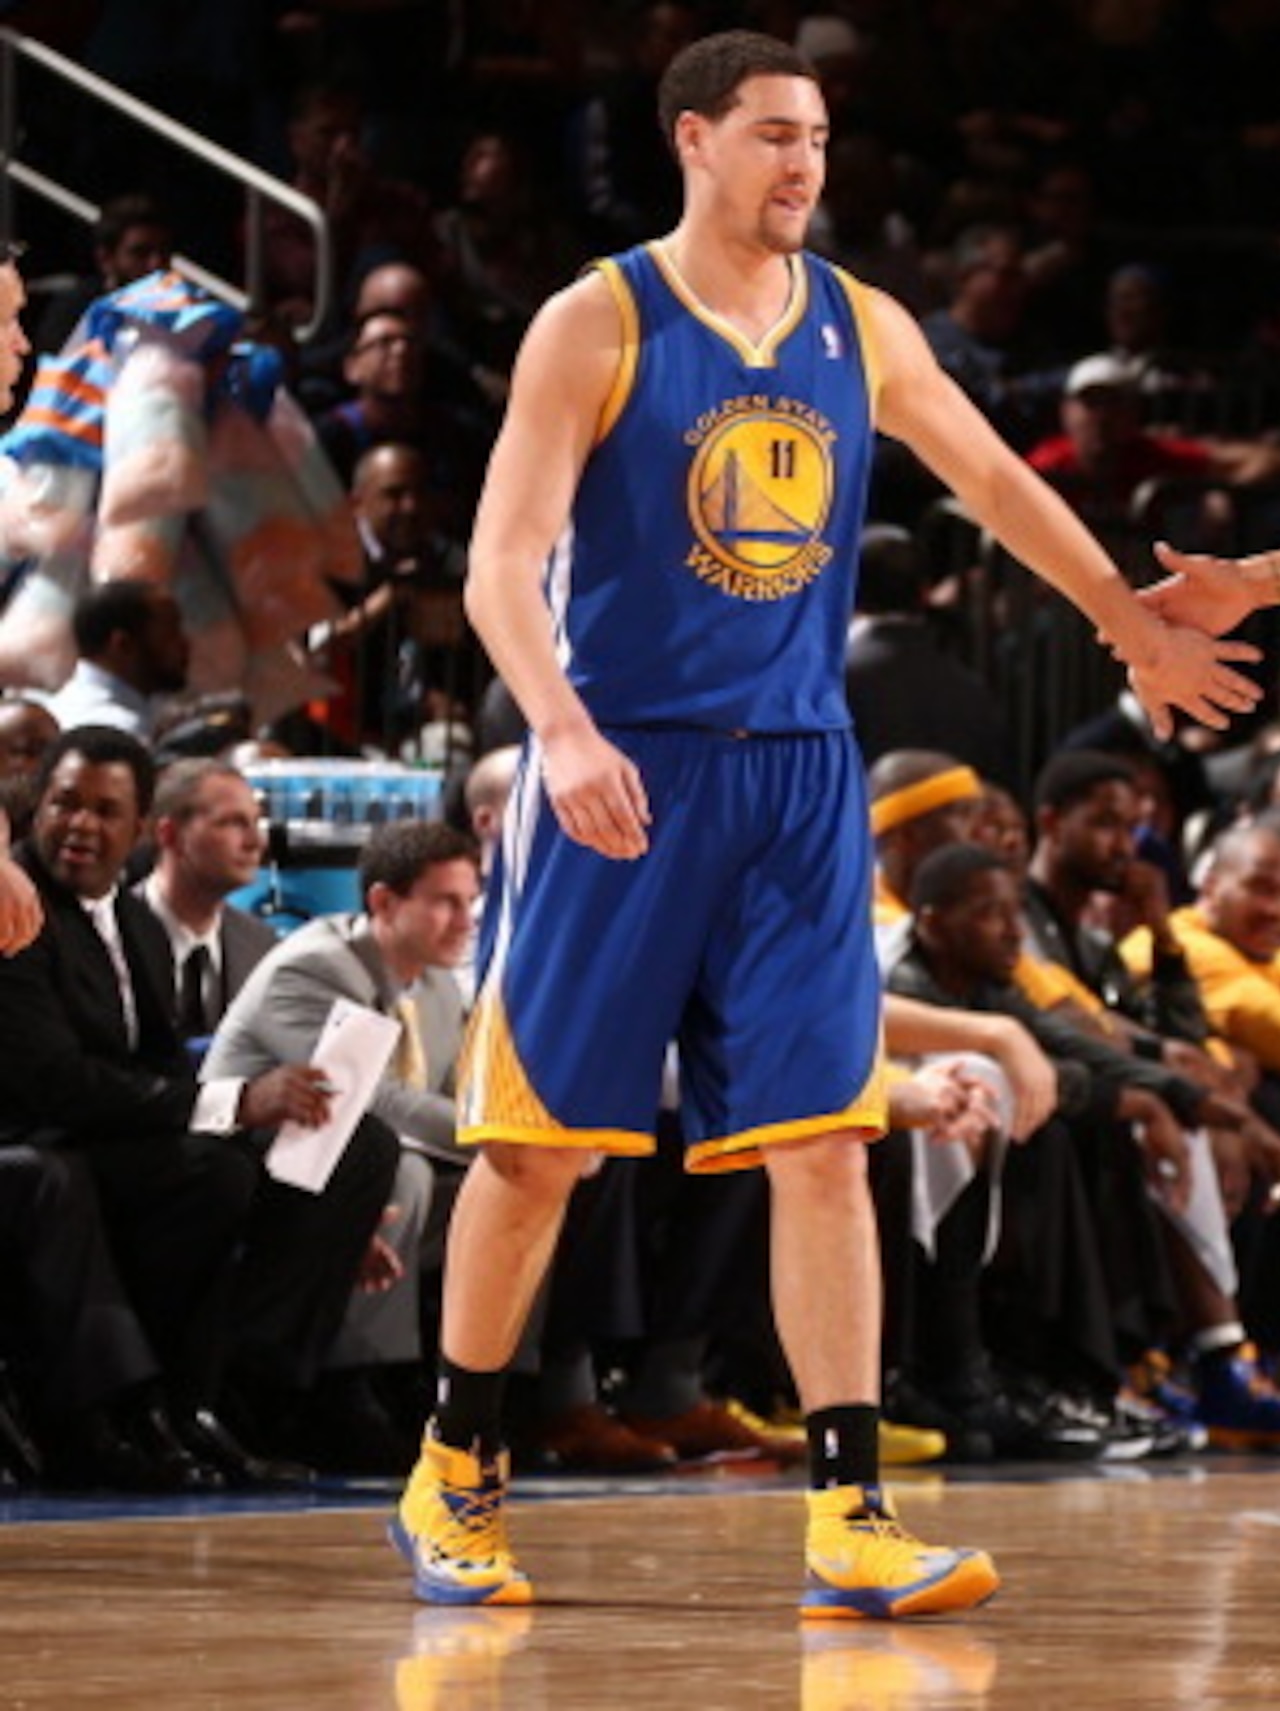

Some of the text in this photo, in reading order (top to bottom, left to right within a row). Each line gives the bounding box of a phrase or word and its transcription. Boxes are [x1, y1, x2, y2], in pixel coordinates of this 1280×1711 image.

[683, 394, 839, 446] GOLDEN STATE
[771, 440, 796, 479] 11
[685, 544, 834, 601] WARRIORS
